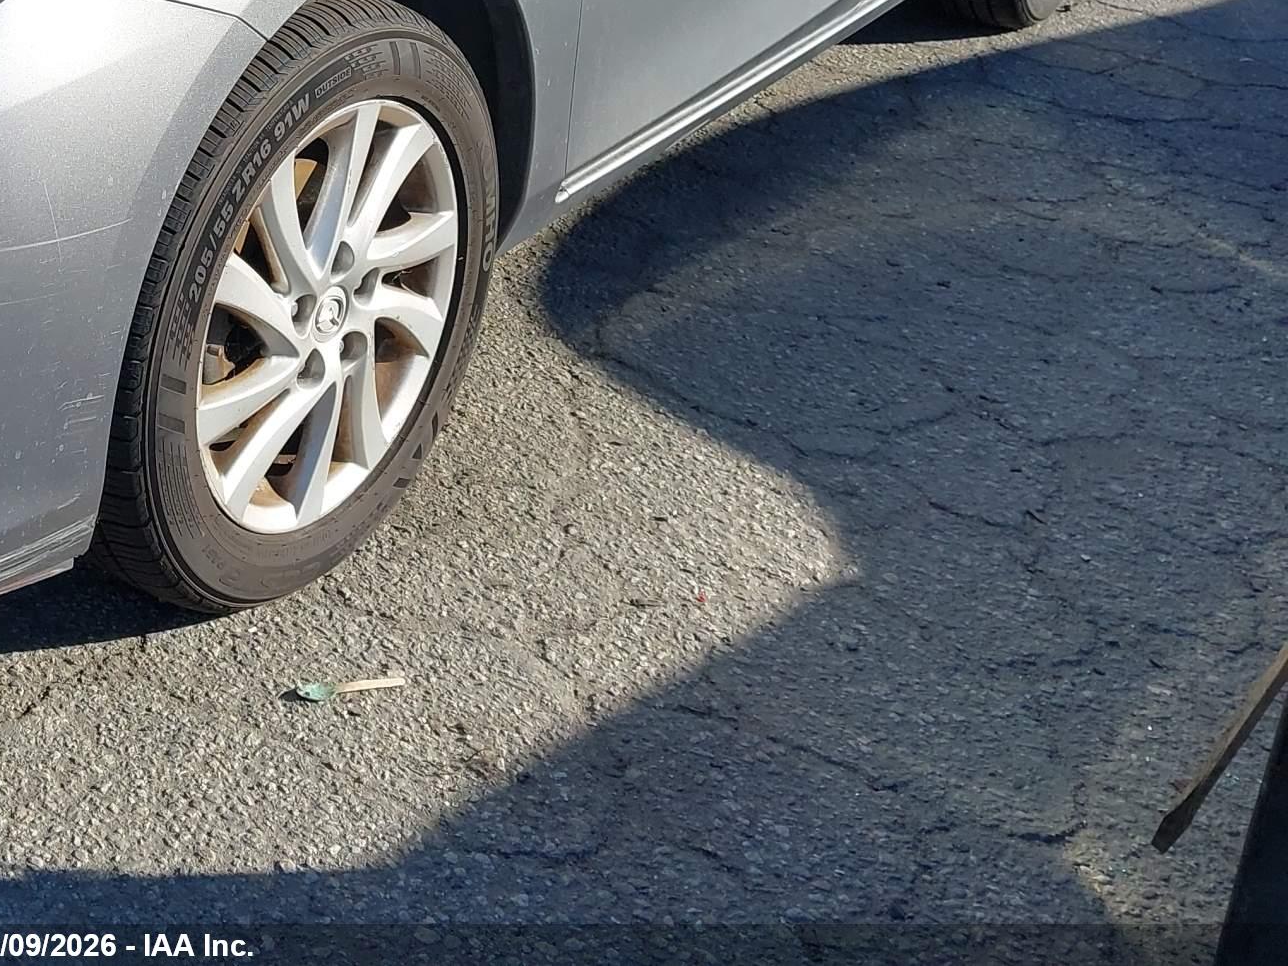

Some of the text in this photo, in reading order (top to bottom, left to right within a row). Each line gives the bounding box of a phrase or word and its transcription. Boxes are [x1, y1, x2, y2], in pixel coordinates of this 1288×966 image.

[316, 68, 351, 97] OUTSIDE
[189, 199, 234, 302] 205/55
[232, 139, 272, 203] ZR16
[274, 92, 310, 141] 91W
